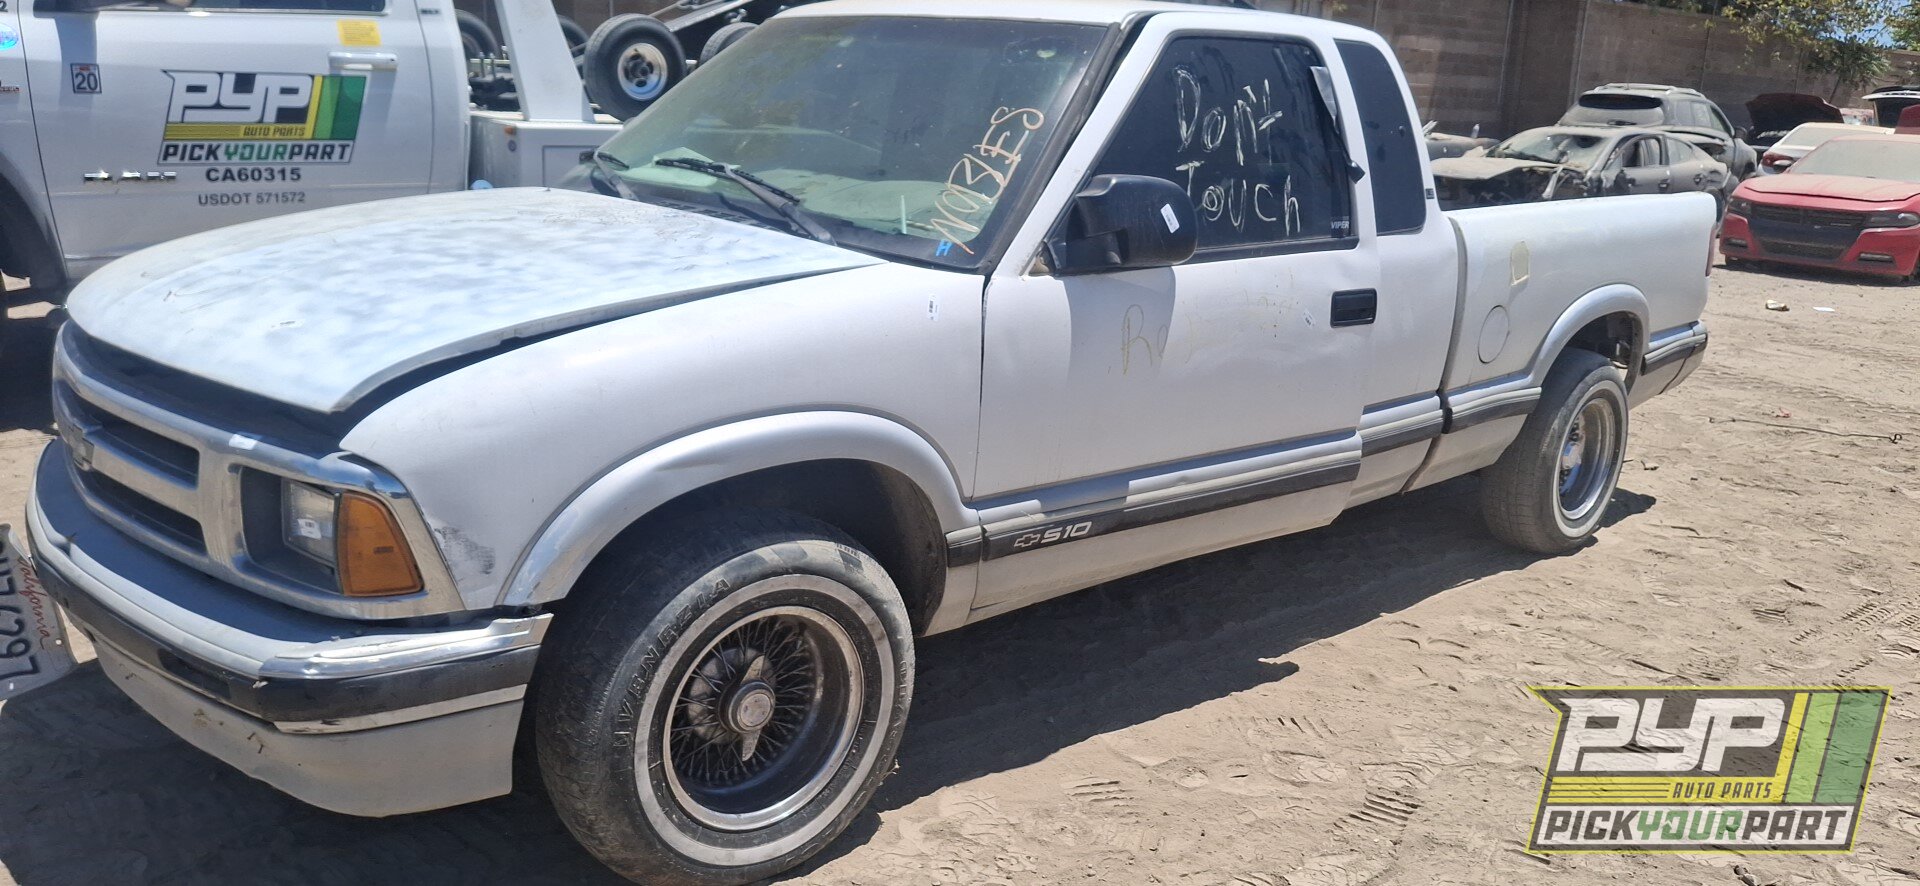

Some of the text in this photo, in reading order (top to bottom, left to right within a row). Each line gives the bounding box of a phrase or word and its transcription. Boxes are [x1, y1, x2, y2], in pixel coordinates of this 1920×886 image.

[75, 71, 98, 92] 20
[166, 71, 314, 124] PYP
[243, 125, 306, 137] AUTO PARTS
[205, 167, 302, 182] CA60315
[198, 191, 306, 206] USDOT 571572
[1331, 220, 1350, 229] VIPER
[1041, 521, 1093, 544] S10
